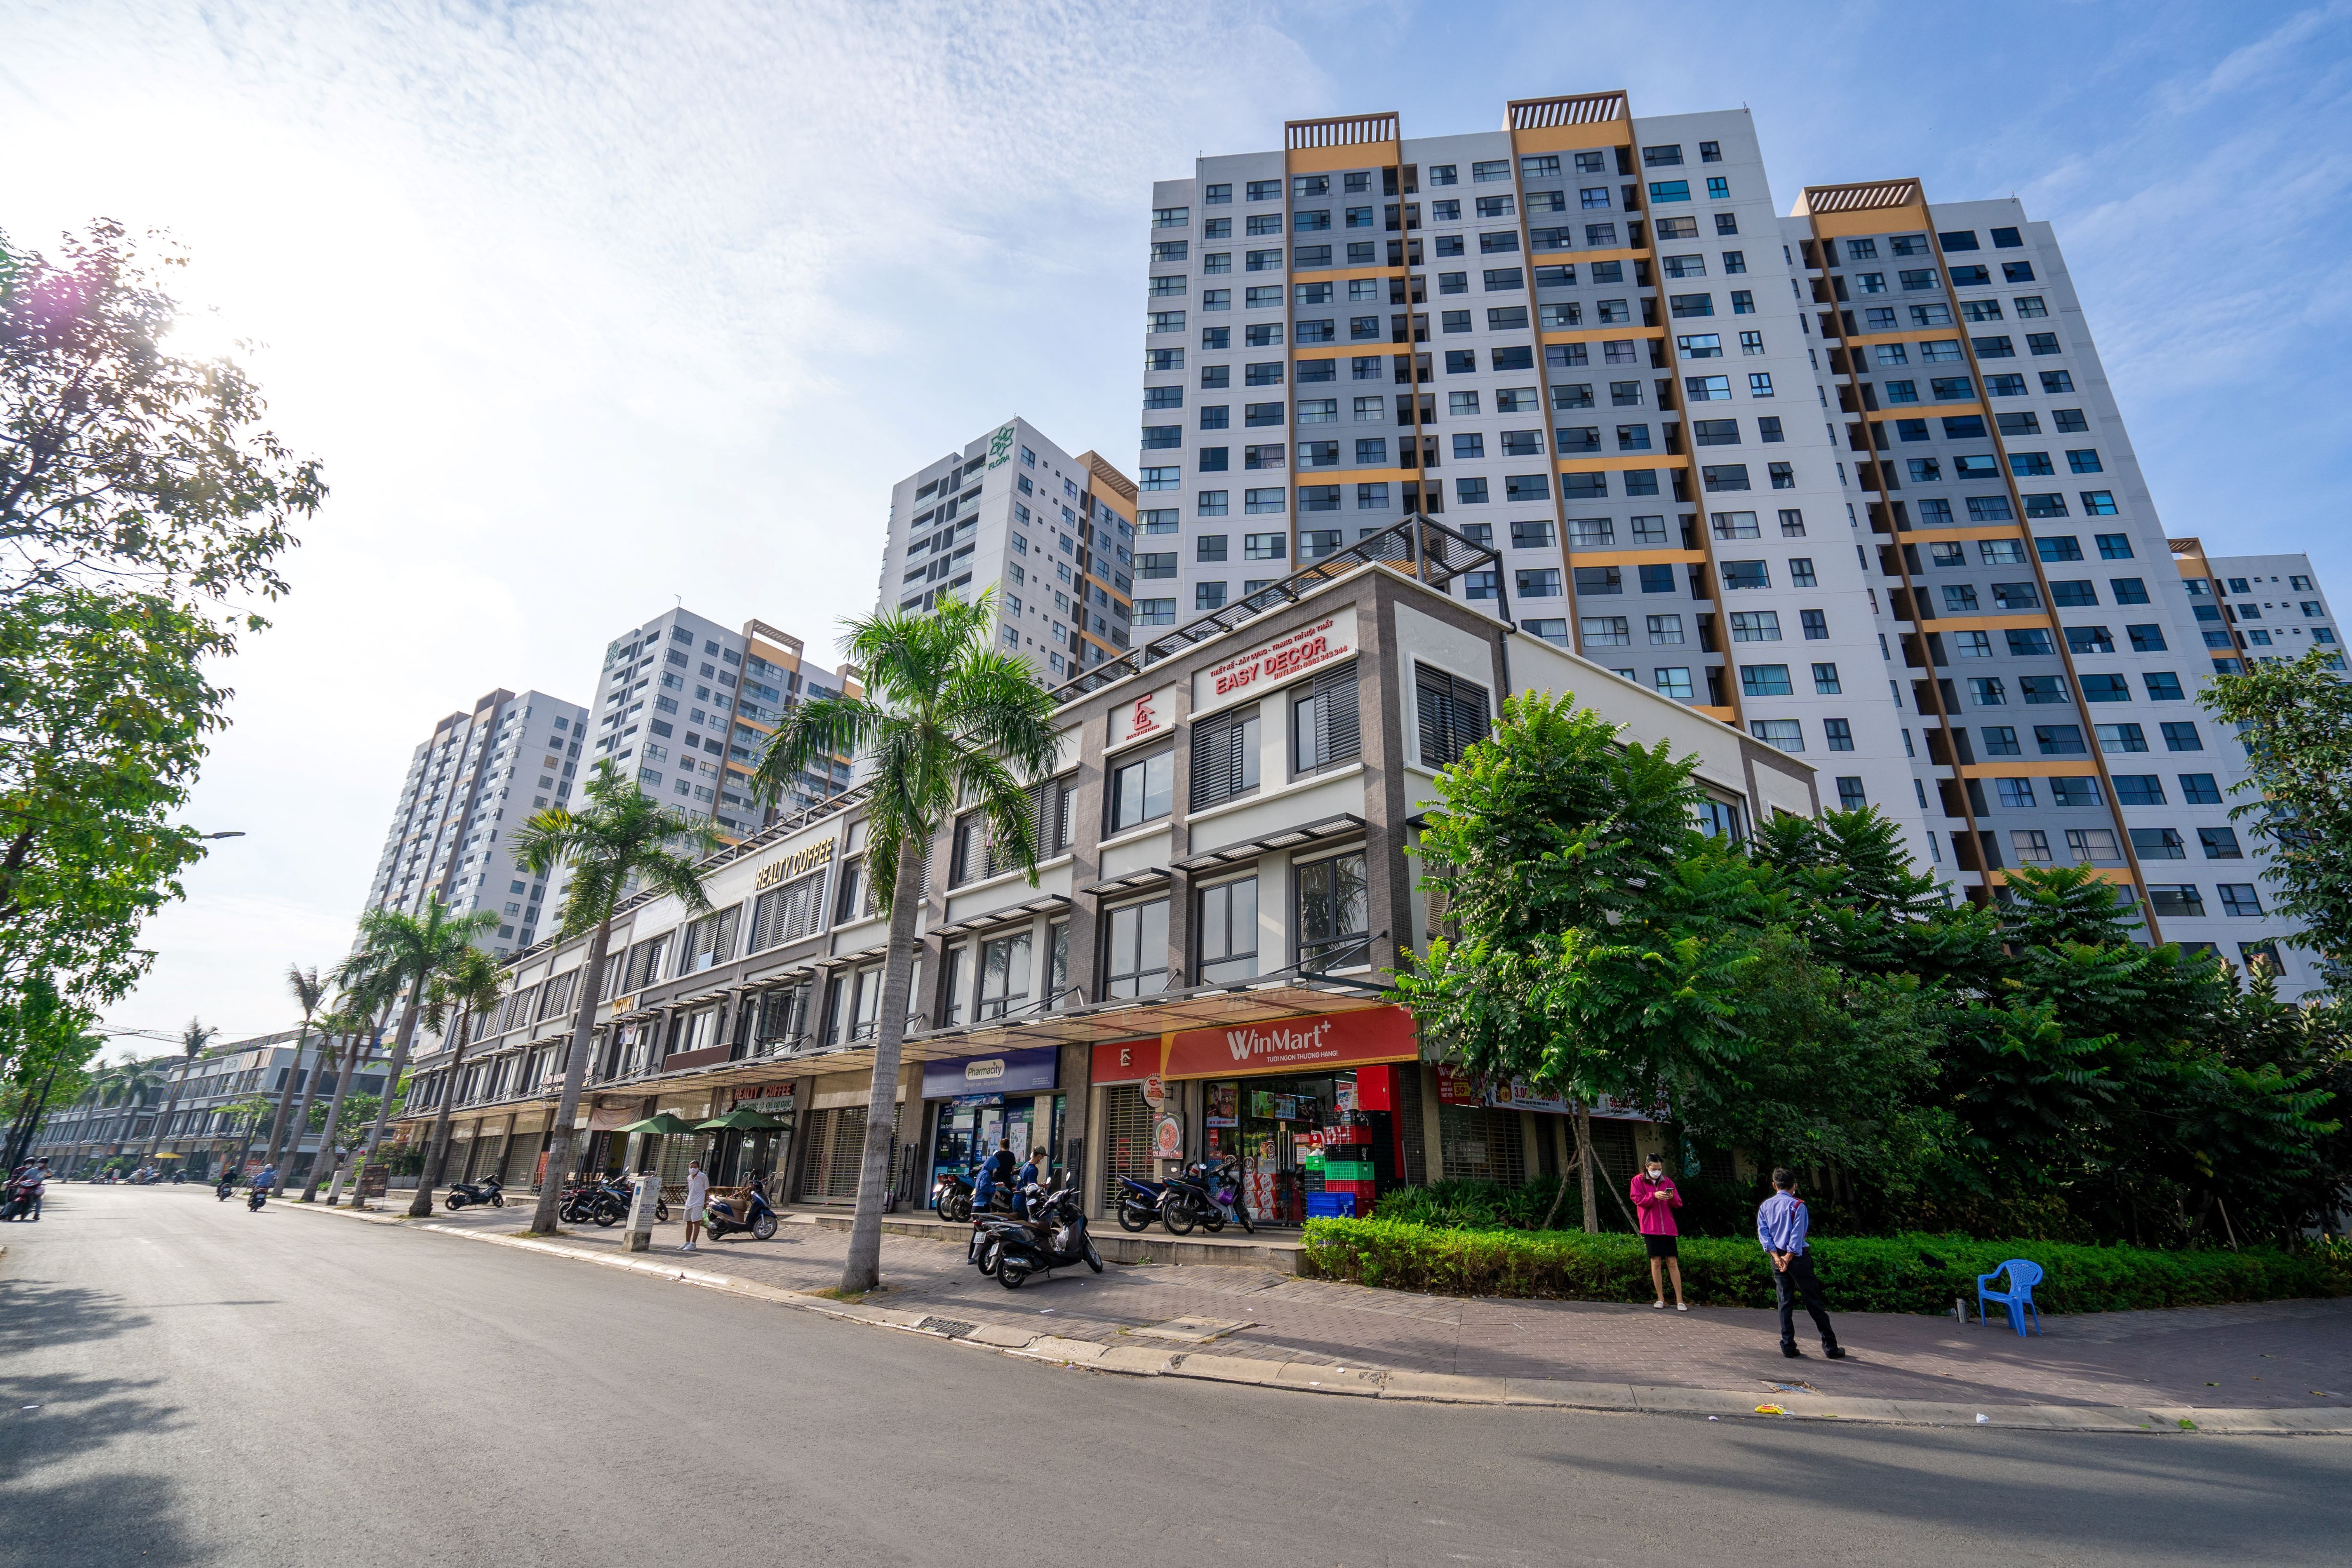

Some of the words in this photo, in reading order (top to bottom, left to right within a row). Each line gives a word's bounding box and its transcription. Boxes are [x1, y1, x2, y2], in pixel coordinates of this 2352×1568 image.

[988, 454, 1009, 470] FLORA
[1209, 666, 1226, 677] THIẾT
[1226, 660, 1235, 670] KẾ
[1238, 655, 1249, 666] XÂY
[1251, 648, 1267, 660] DỰNG
[1271, 638, 1292, 651] TRANG
[1293, 632, 1304, 642] TRÍ
[1304, 628, 1315, 637] NỘI
[1316, 619, 1334, 632] THẤT
[1216, 663, 1259, 695] EASY
[1264, 636, 1326, 676] DECOR
[1274, 665, 1303, 680] HOTLINE:
[1303, 659, 1319, 669] 0961
[1320, 651, 1333, 661] 343
[1334, 645, 1348, 656] 344
[755, 855, 793, 891] REALTY
[793, 836, 834, 875] COFFEE
[611, 995, 635, 1017] MIZUKI
[1297, 1052, 1320, 1060] THƯỢNG
[1320, 1050, 1338, 1059] HẠNG!
[968, 1063, 1002, 1077] Pharmacity
[734, 1086, 760, 1100] REALTY
[765, 1083, 792, 1097] COFFEE
